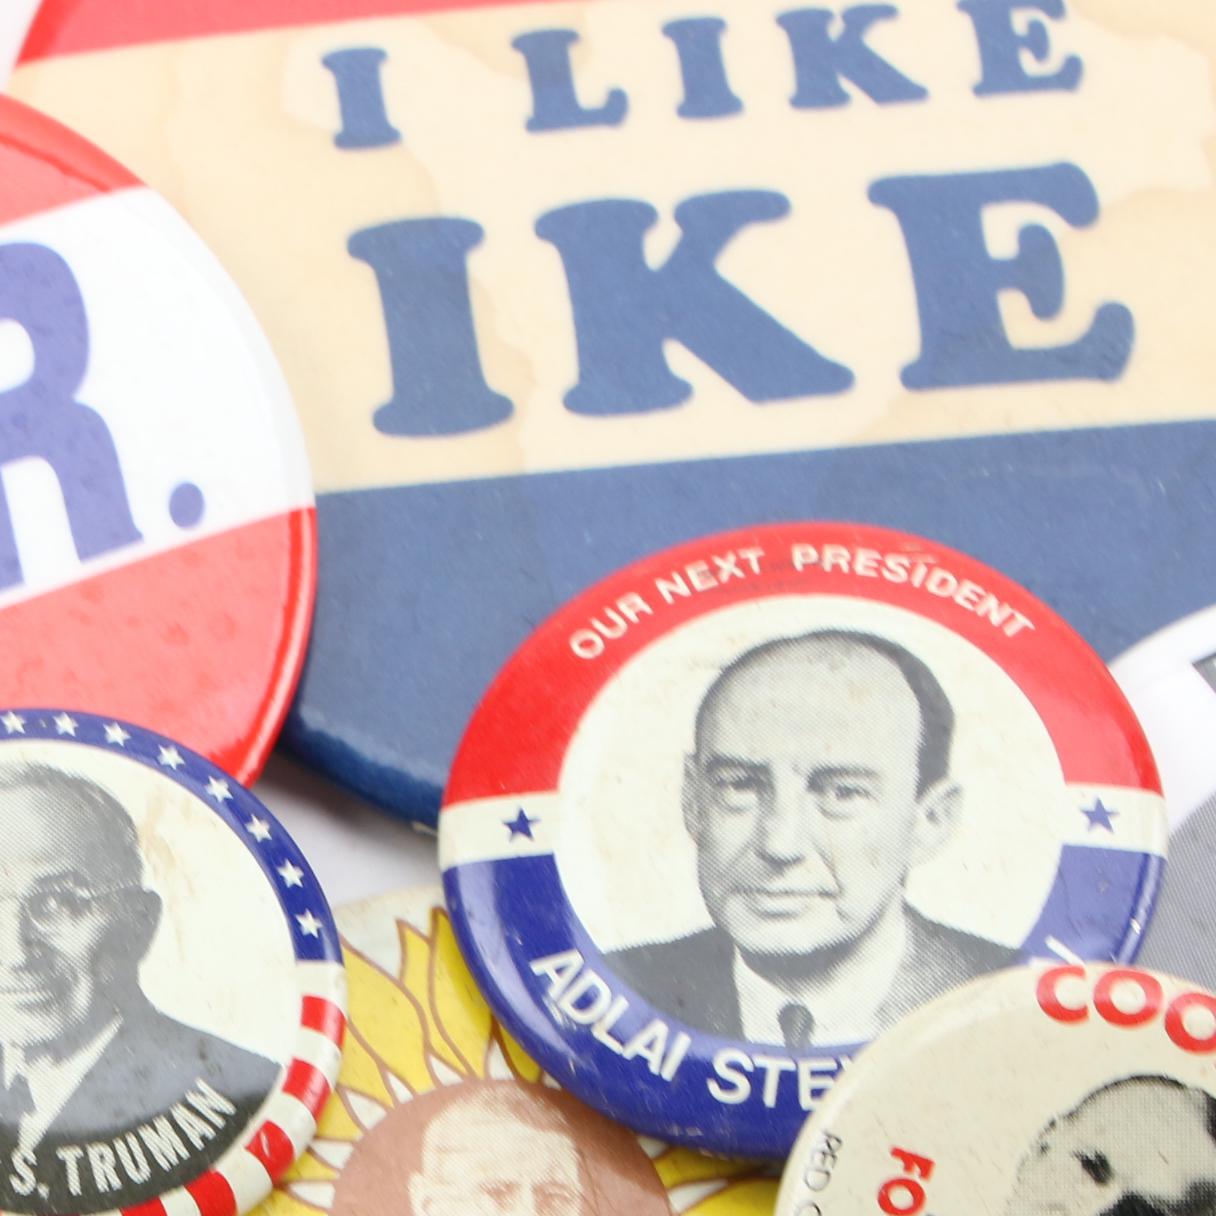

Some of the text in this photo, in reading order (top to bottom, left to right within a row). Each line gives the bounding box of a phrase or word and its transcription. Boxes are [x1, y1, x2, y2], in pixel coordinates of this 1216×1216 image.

[321, 0, 1085, 150] I LIKE
[345, 161, 1137, 439] IKE
[568, 544, 1036, 661] OUR NEXT PRESIDENT
[530, 949, 856, 1112] ADLAI STE
[8, 1146, 50, 1199] S.
[58, 1078, 237, 1196] TRUMAN
[803, 1129, 844, 1193] RED
